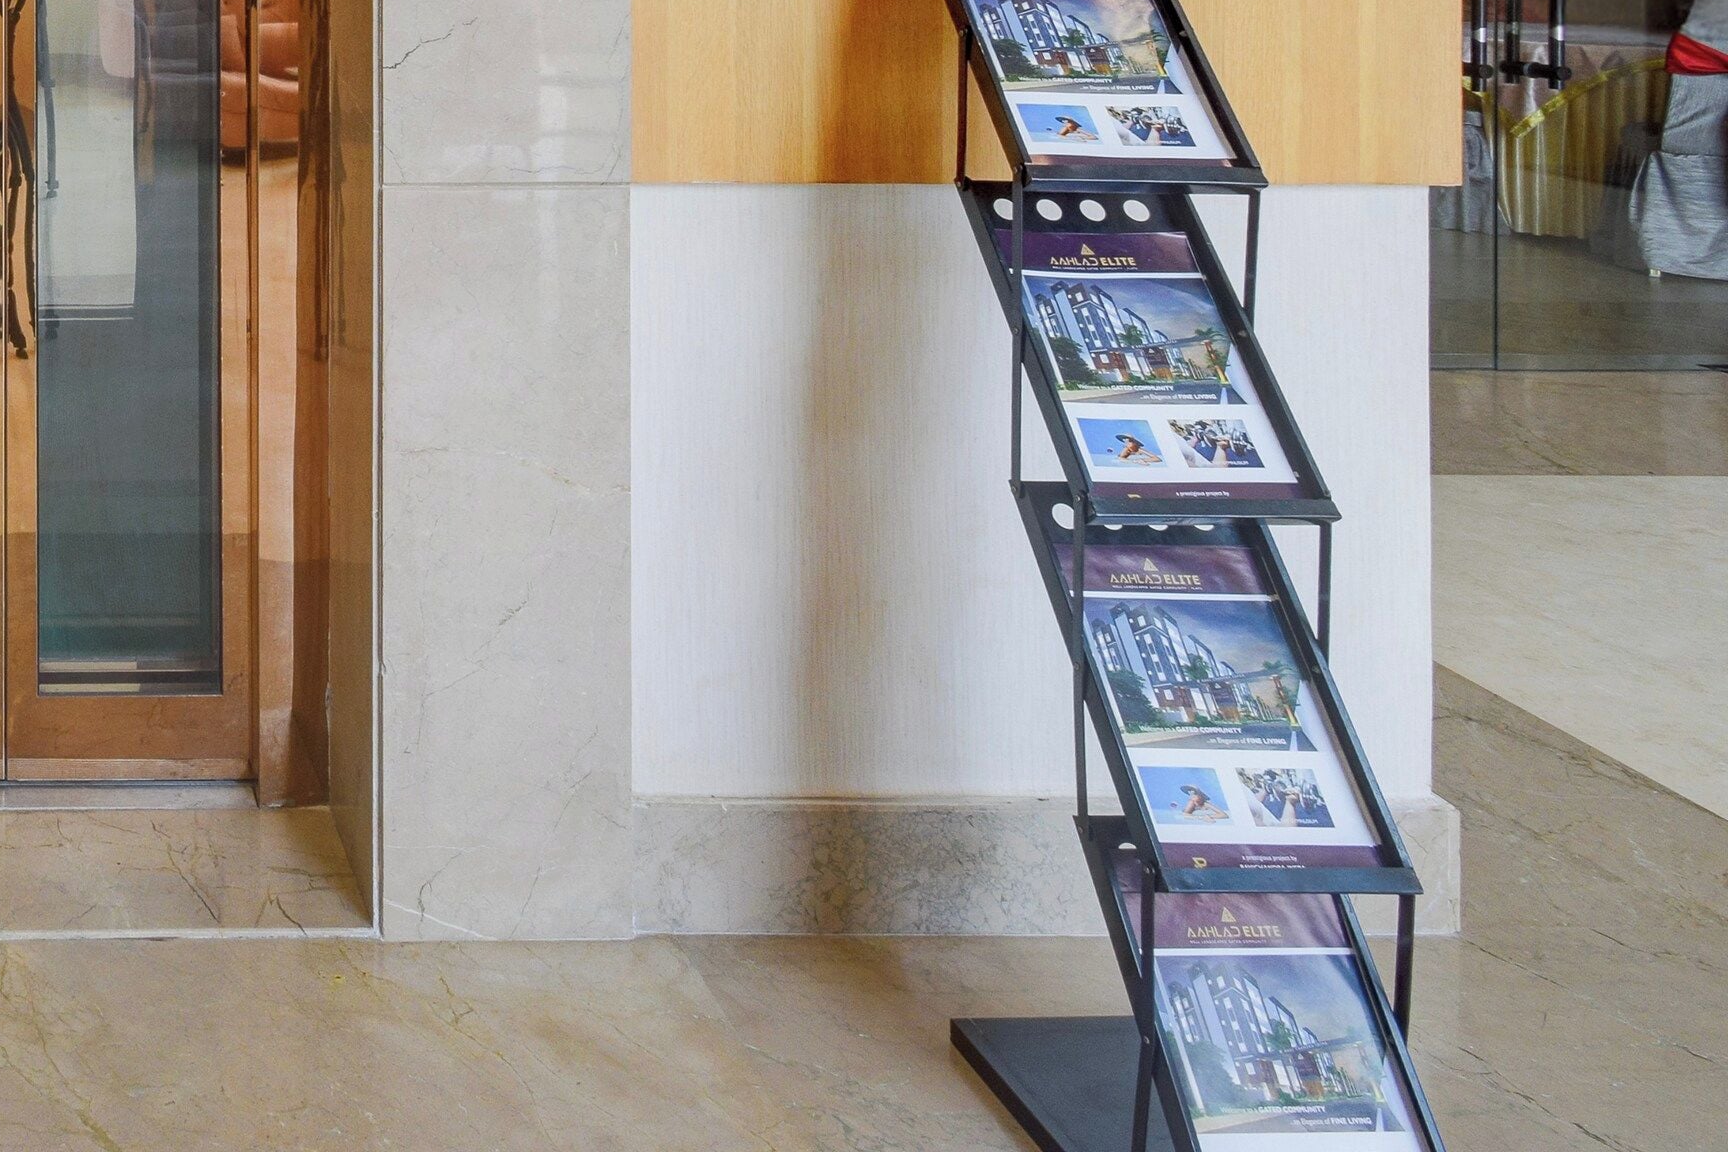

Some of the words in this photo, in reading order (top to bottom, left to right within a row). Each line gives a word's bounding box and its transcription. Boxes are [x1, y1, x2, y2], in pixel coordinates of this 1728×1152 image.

[1100, 257, 1137, 266] ELITE
[1164, 574, 1201, 585] ELITE
[1242, 926, 1281, 937] ELITE
[1349, 1117, 1372, 1125] LIVING
